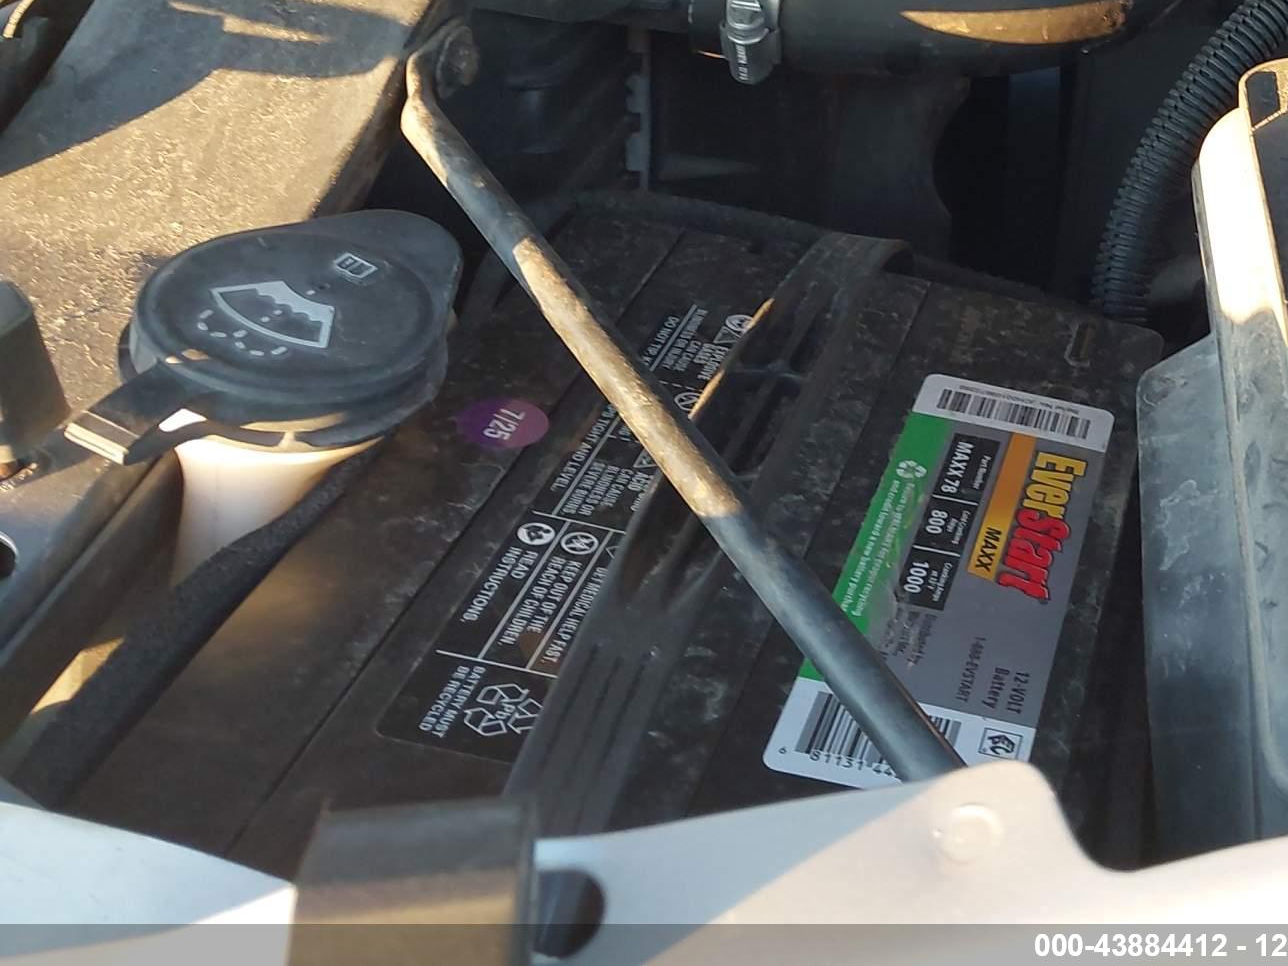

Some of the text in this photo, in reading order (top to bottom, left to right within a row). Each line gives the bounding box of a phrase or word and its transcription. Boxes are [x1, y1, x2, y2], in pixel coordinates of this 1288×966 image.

[654, 328, 670, 344] NOT
[663, 316, 680, 328] DO
[483, 408, 526, 441] 7/25
[586, 418, 610, 443] TIGHT
[571, 441, 593, 462] AND
[940, 440, 975, 495] MAXX 78
[550, 461, 582, 492] LEVEL.
[579, 461, 606, 490] SEVERE
[600, 468, 635, 508] CAN CAUSE
[628, 471, 650, 492] ACID
[892, 480, 901, 493] and
[973, 454, 992, 491] Part Number
[577, 465, 621, 516] BLINDNESS OR
[883, 492, 896, 510] credit
[871, 509, 889, 536] toward
[925, 509, 949, 536] 800
[997, 450, 1089, 601] EverStart
[863, 540, 875, 557] new
[975, 526, 1003, 573] MAXX
[511, 550, 539, 580] READ
[850, 555, 871, 583] battery
[903, 560, 930, 594] 1000
[460, 546, 523, 623] INSTRUCTIONS.
[526, 560, 584, 634] KEEP OUT OF THE
[852, 583, 873, 616] recycling
[497, 556, 567, 647] REACH OF CHILDREN.
[568, 582, 603, 622] MEDICAL
[557, 620, 581, 641] HELP
[541, 638, 568, 664] FAST.
[418, 665, 471, 732] BE RECYCLED
[431, 665, 487, 739] BATTERY MUST
[981, 667, 1011, 710] Battery
[1006, 672, 1031, 715] 12-VOLT
[494, 702, 517, 720] Pb
